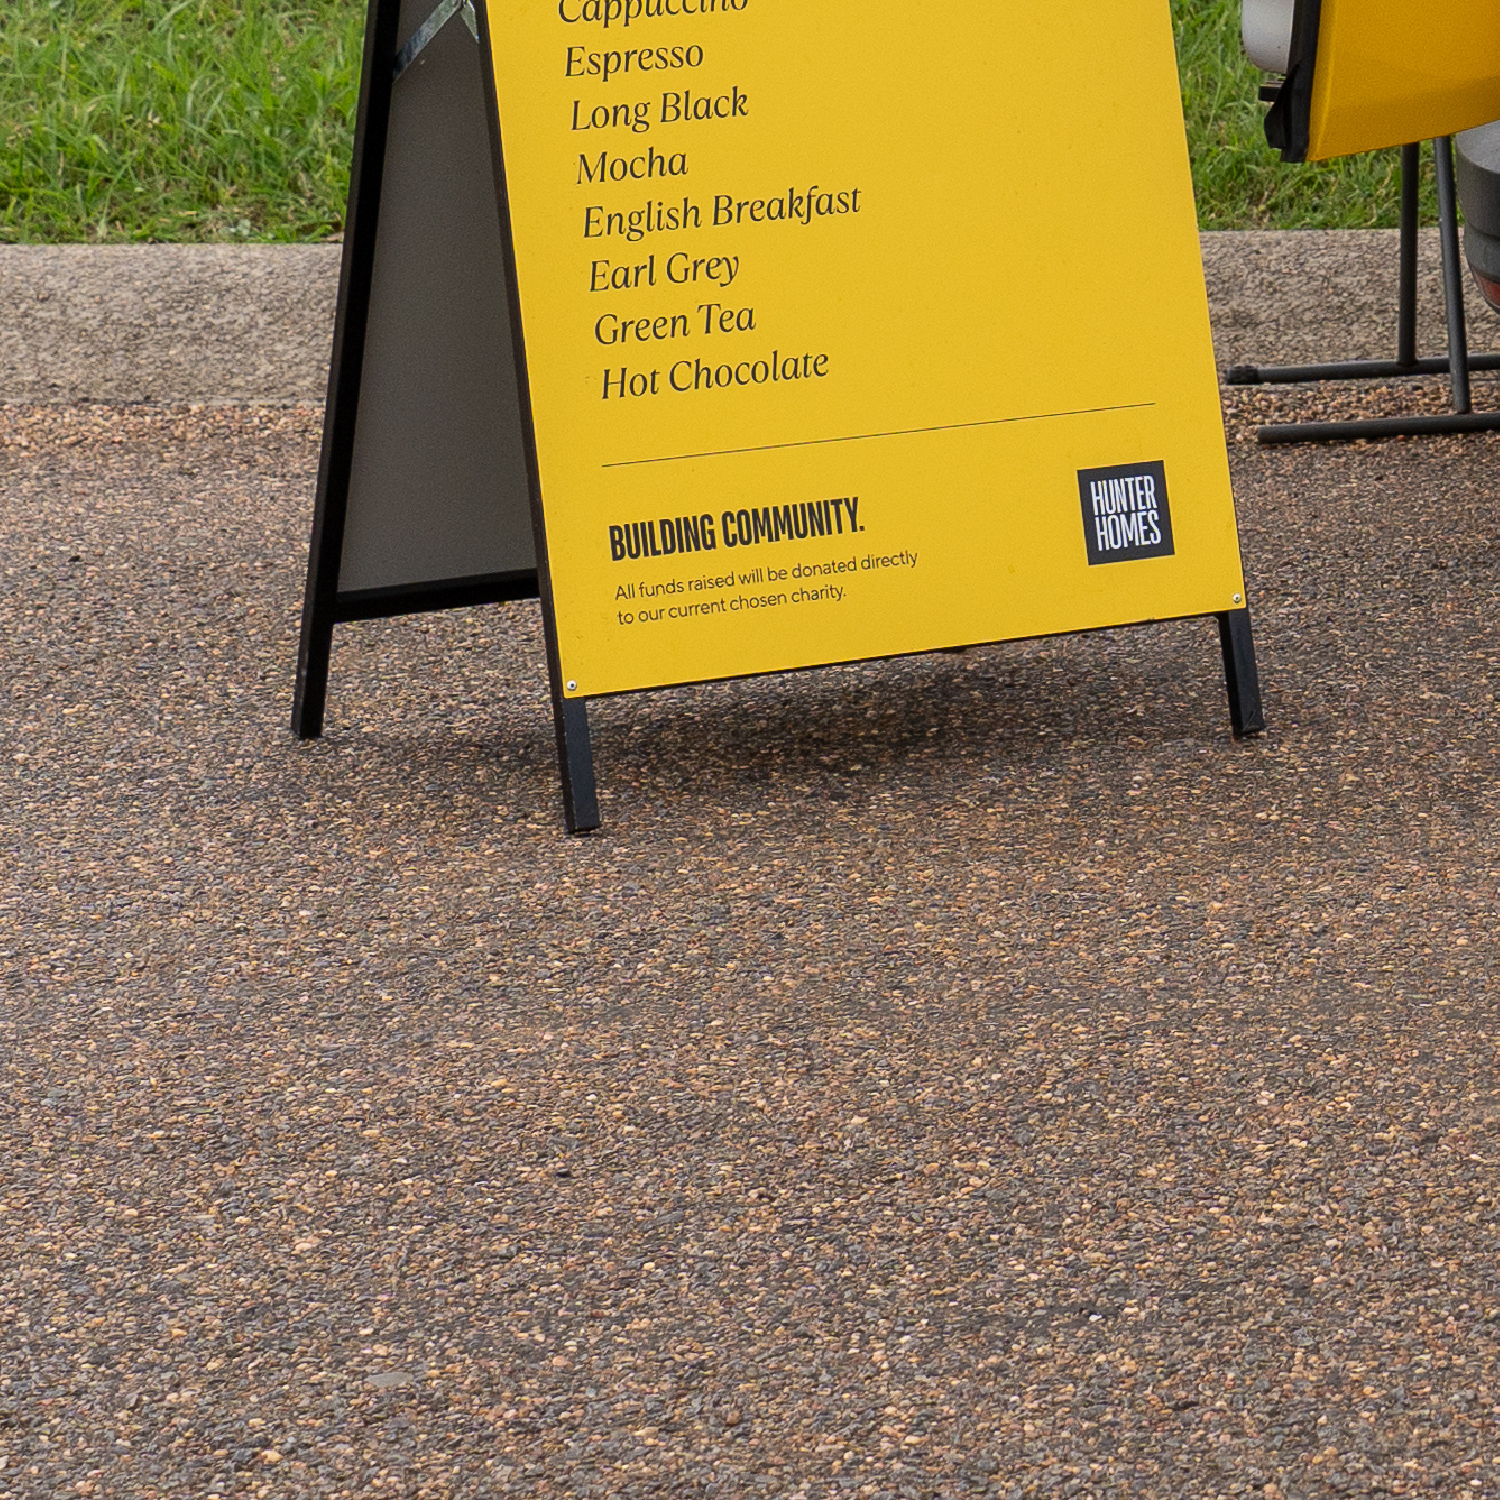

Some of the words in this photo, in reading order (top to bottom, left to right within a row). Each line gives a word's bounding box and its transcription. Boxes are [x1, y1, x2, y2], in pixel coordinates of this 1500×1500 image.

[564, 44, 705, 83] Espresso
[571, 100, 652, 133] Long
[658, 85, 750, 123] Black
[575, 146, 689, 185] Mocha
[582, 196, 703, 242] English
[711, 185, 862, 226] Breakfast
[588, 254, 658, 293] Earl
[666, 251, 740, 288] Grey
[593, 313, 691, 345] Green
[697, 303, 758, 335] Tea
[601, 367, 661, 400] Hot
[668, 349, 830, 392] Chocolate
[1090, 475, 1158, 516] HUNTER
[608, 513, 717, 562] BUILDING
[721, 496, 867, 548] COMMUNITY.
[1094, 510, 1162, 552] HOMES
[615, 583, 636, 601] All
[638, 580, 685, 598] funds
[687, 571, 735, 592] raised
[737, 567, 764, 585] will
[766, 565, 788, 582] be
[791, 555, 858, 580] donated
[860, 550, 918, 570] directly
[617, 610, 635, 626] to
[638, 608, 665, 624] our
[667, 598, 728, 620] current
[729, 592, 788, 611] chosen
[791, 583, 848, 603] charity.
